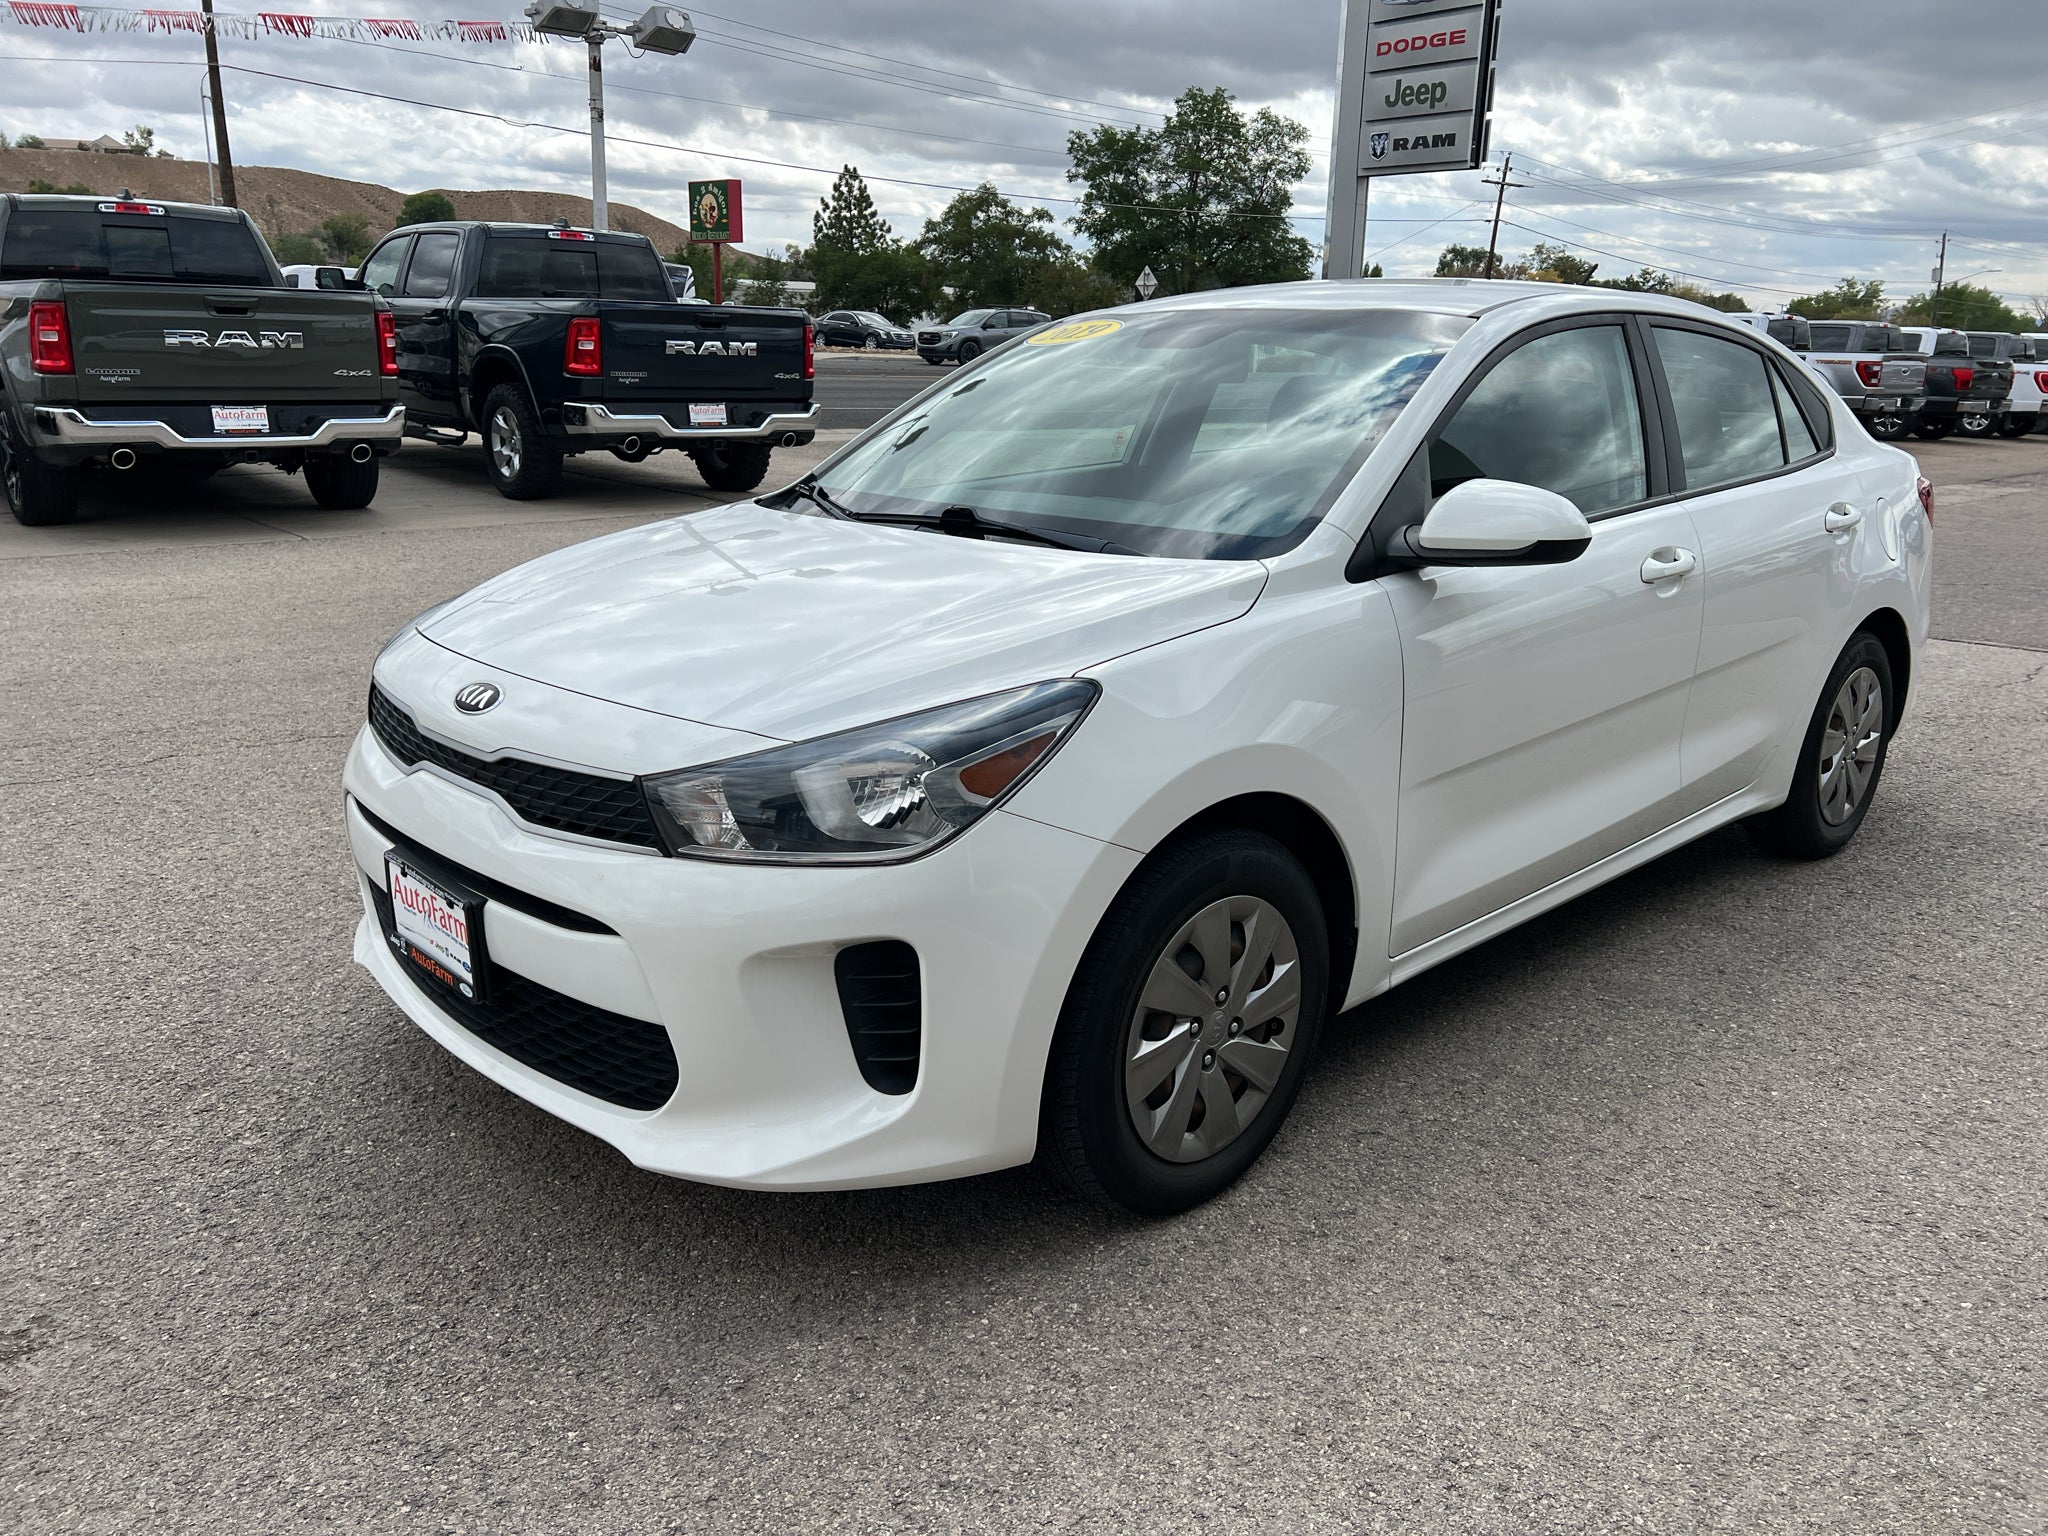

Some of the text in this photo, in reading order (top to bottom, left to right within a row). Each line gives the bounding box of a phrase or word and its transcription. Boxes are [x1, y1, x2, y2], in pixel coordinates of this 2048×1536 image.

[1376, 29, 1467, 57] DODGE
[1384, 79, 1447, 110] Jeep
[1392, 132, 1457, 151] RAM
[163, 329, 304, 349] RAM
[665, 339, 758, 356] RAM
[214, 410, 267, 420] AutoFarm
[690, 406, 725, 415] AutoFarm
[457, 684, 495, 709] KIA
[394, 873, 469, 944] AutoFarm
[410, 946, 454, 987] AutoFarm
